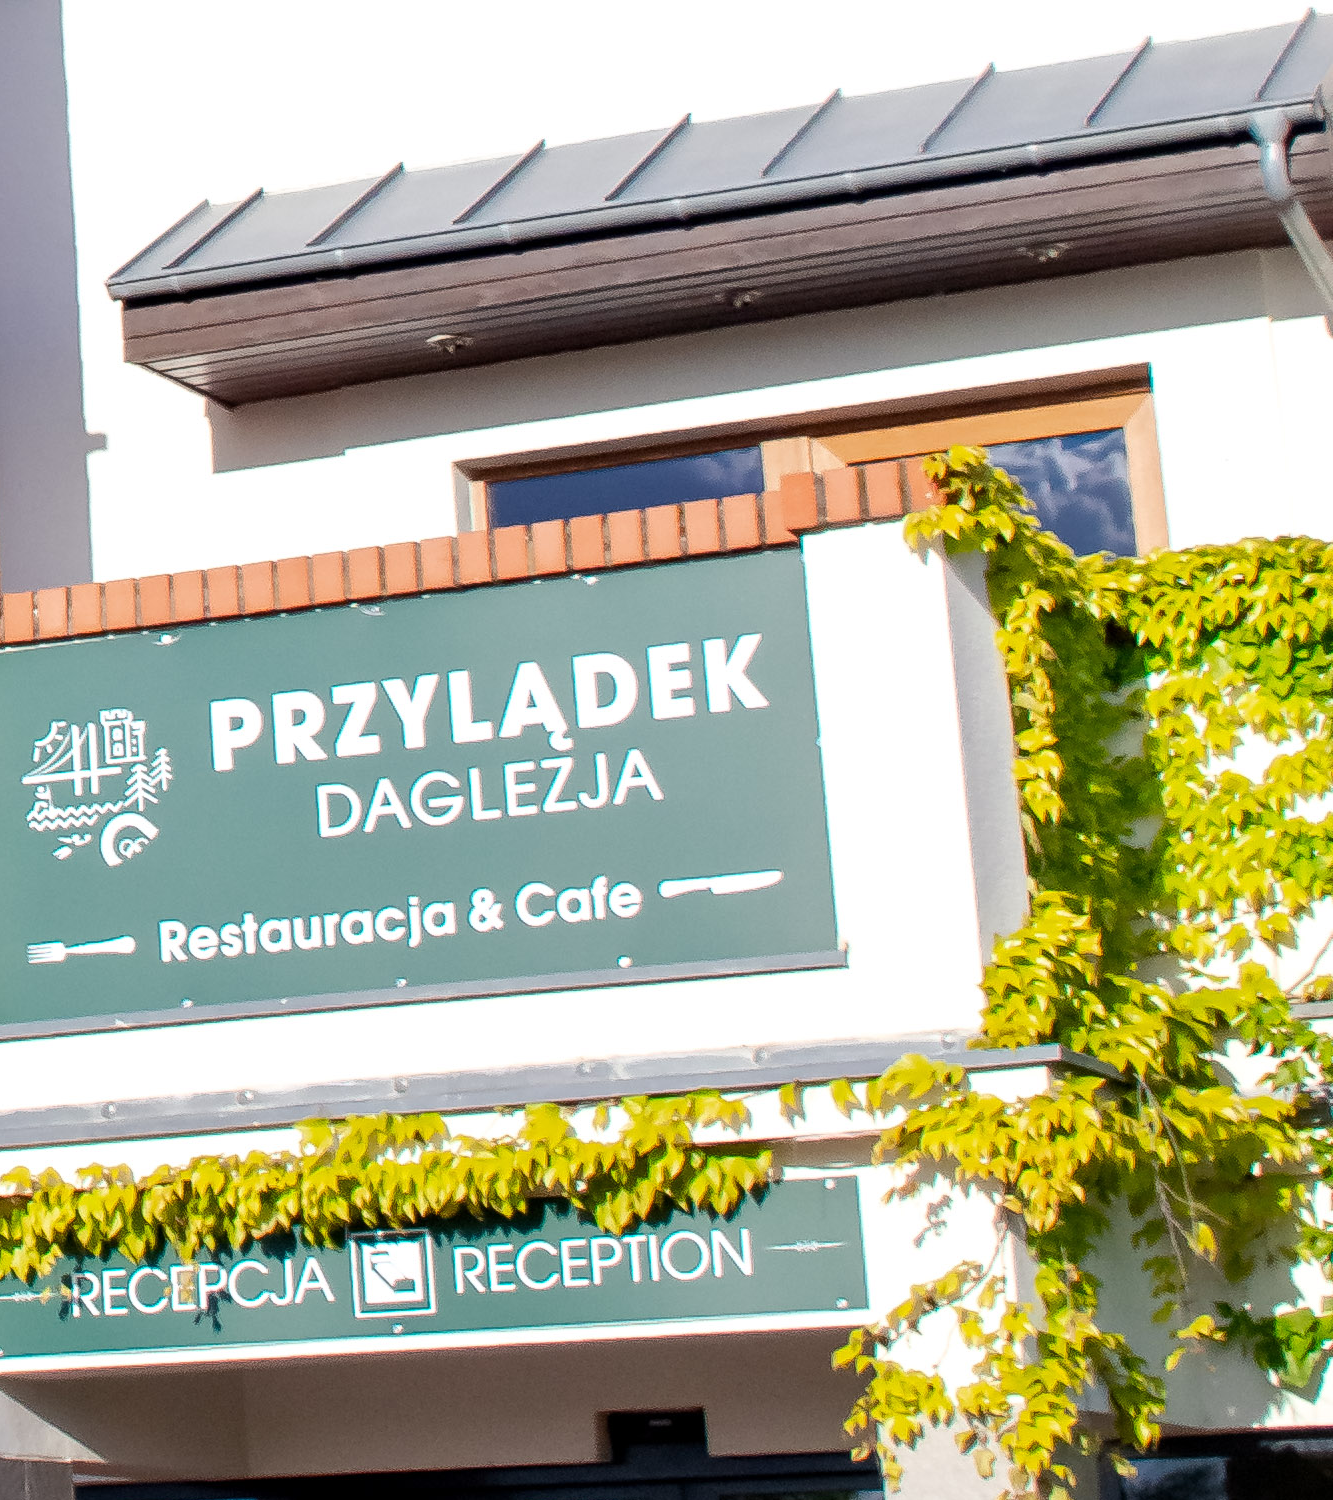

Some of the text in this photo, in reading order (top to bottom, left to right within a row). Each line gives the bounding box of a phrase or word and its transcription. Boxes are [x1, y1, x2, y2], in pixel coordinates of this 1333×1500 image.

[209, 633, 770, 773] PRZYLĄDEK
[316, 747, 666, 840] DAGLEZJA
[159, 873, 644, 963] Restauracja & Cafe
[71, 1228, 755, 1318] RECEPCJA RECEPTION
